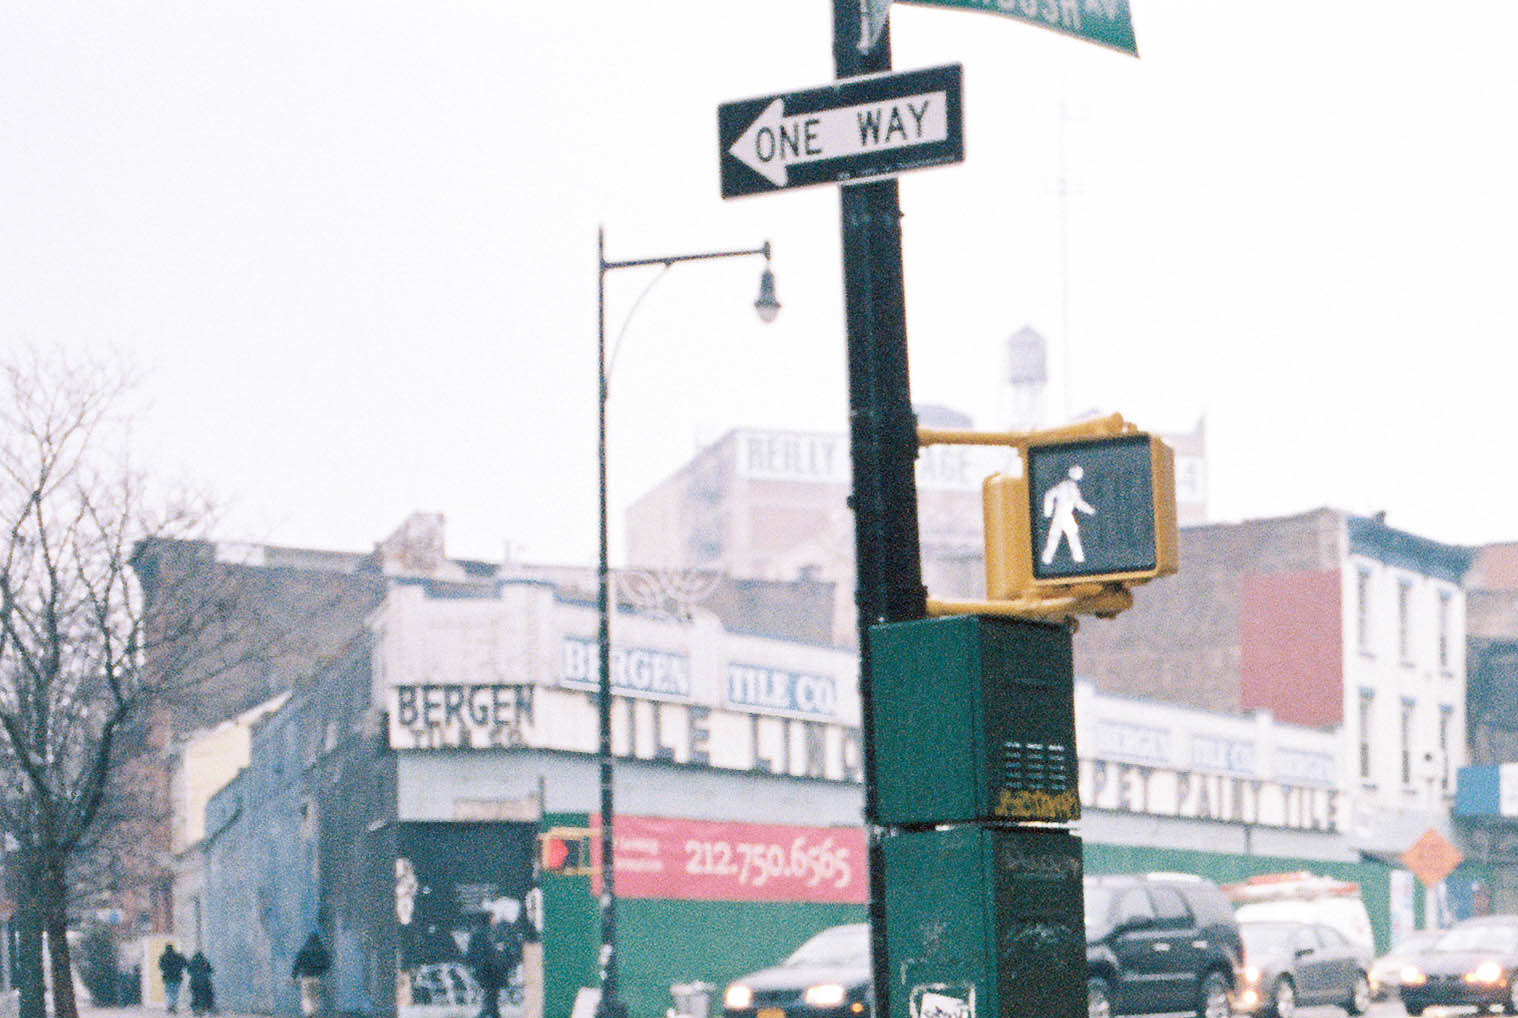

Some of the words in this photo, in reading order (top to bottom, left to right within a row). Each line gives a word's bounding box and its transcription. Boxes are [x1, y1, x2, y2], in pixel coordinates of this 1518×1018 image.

[753, 118, 823, 164] ONE
[857, 100, 930, 147] WAY
[398, 684, 535, 728] BERGEN
[587, 694, 711, 770] ILE
[1176, 770, 1265, 828] PAINT
[1280, 782, 1339, 835] TILE
[684, 836, 852, 889] 212.750.6565
